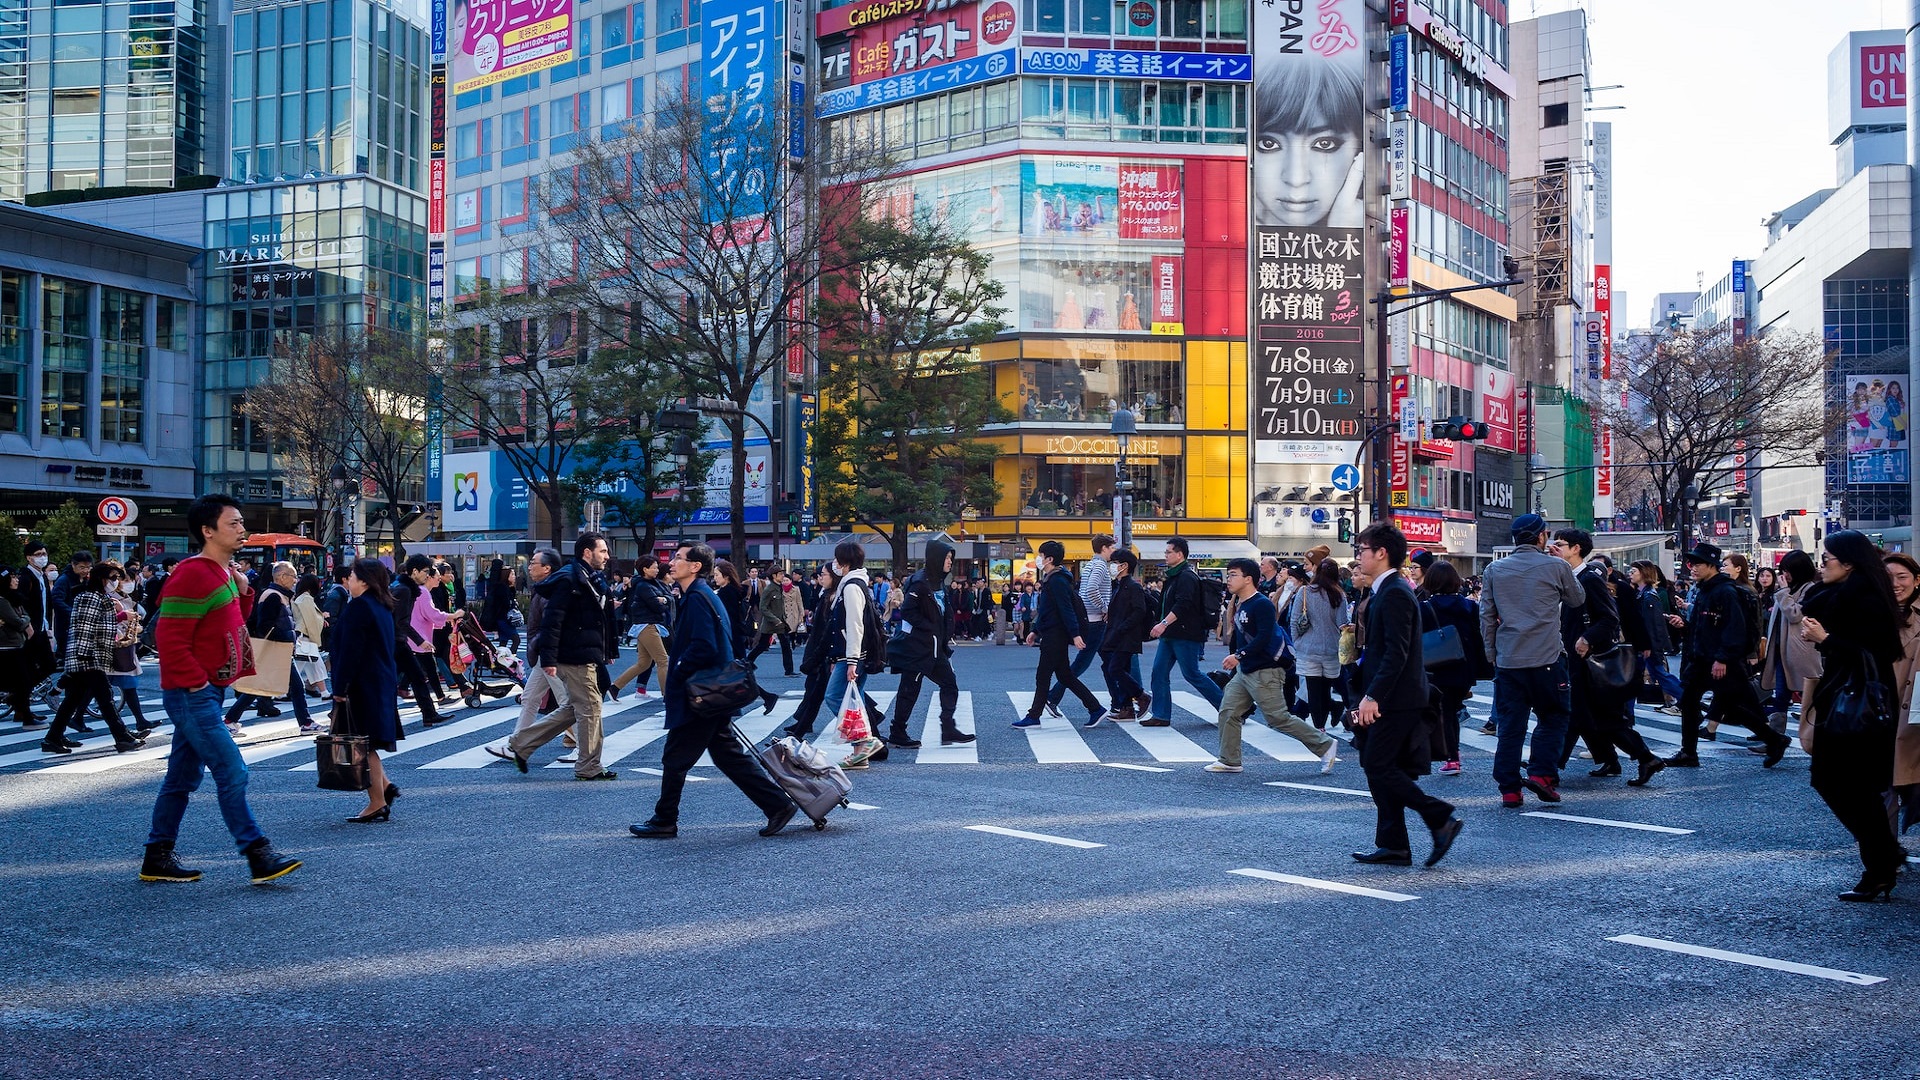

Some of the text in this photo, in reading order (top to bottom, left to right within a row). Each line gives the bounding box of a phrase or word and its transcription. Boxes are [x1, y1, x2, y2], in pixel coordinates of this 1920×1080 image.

[433, 0, 444, 50] 急リバブル
[985, 20, 1012, 34] ガスト
[1132, 12, 1153, 20] ガスト
[1279, 0, 1303, 54] PAN
[857, 41, 889, 64] Café
[892, 21, 971, 72] ガスト
[480, 56, 493, 70] 4F
[823, 52, 850, 79] 7F
[857, 61, 889, 76] レストラン
[986, 56, 1007, 74] 6F
[1029, 52, 1081, 70] AEON
[1095, 53, 1248, 76] 英会話イーオン
[867, 62, 979, 104] 英会話イーオン
[1394, 42, 1404, 104] 英会話イーオン
[742, 6, 766, 196] コンタクトの
[431, 143, 444, 151] 8F
[1394, 128, 1405, 193] 渋谷駅前ビル
[432, 161, 443, 200] 外貨両替
[1120, 170, 1158, 189] 沖縄
[1119, 189, 1179, 199] フォトウェディング
[1122, 217, 1161, 225] ドレスのまま
[1392, 208, 1408, 218] 5F
[251, 230, 316, 244] SHIBUYA
[1259, 232, 1361, 260] 国立代々木
[1392, 222, 1403, 275] La Fiesta
[217, 239, 358, 264] MARK CITY
[253, 271, 313, 284] 渋谷 マークシティ
[430, 252, 444, 316] 加藤眼科
[1258, 262, 1362, 290] 競技場第一
[1160, 262, 1175, 317] 毎日開催
[1597, 276, 1609, 300] 免税
[1259, 292, 1325, 321] 体育館
[1335, 290, 1351, 311] 3
[1330, 305, 1359, 325] Days!
[1160, 325, 1176, 333] 4F
[1296, 329, 1324, 339] 2016
[1587, 321, 1600, 343] OS
[1265, 346, 1355, 375] 7月8日(金)
[1265, 377, 1355, 405] 7月9日(土)
[1261, 407, 1360, 436] 7月10日(日)
[1407, 401, 1416, 438] 渋谷駅前
[1488, 400, 1509, 425] アコム
[1495, 431, 1503, 444] 3F
[1067, 456, 1140, 465] EN PROVCE
[110, 467, 144, 481] 渋谷駅
[1394, 493, 1407, 505] 薬
[1482, 480, 1513, 509] LUSH
[1410, 520, 1436, 536] サンドラッグ
